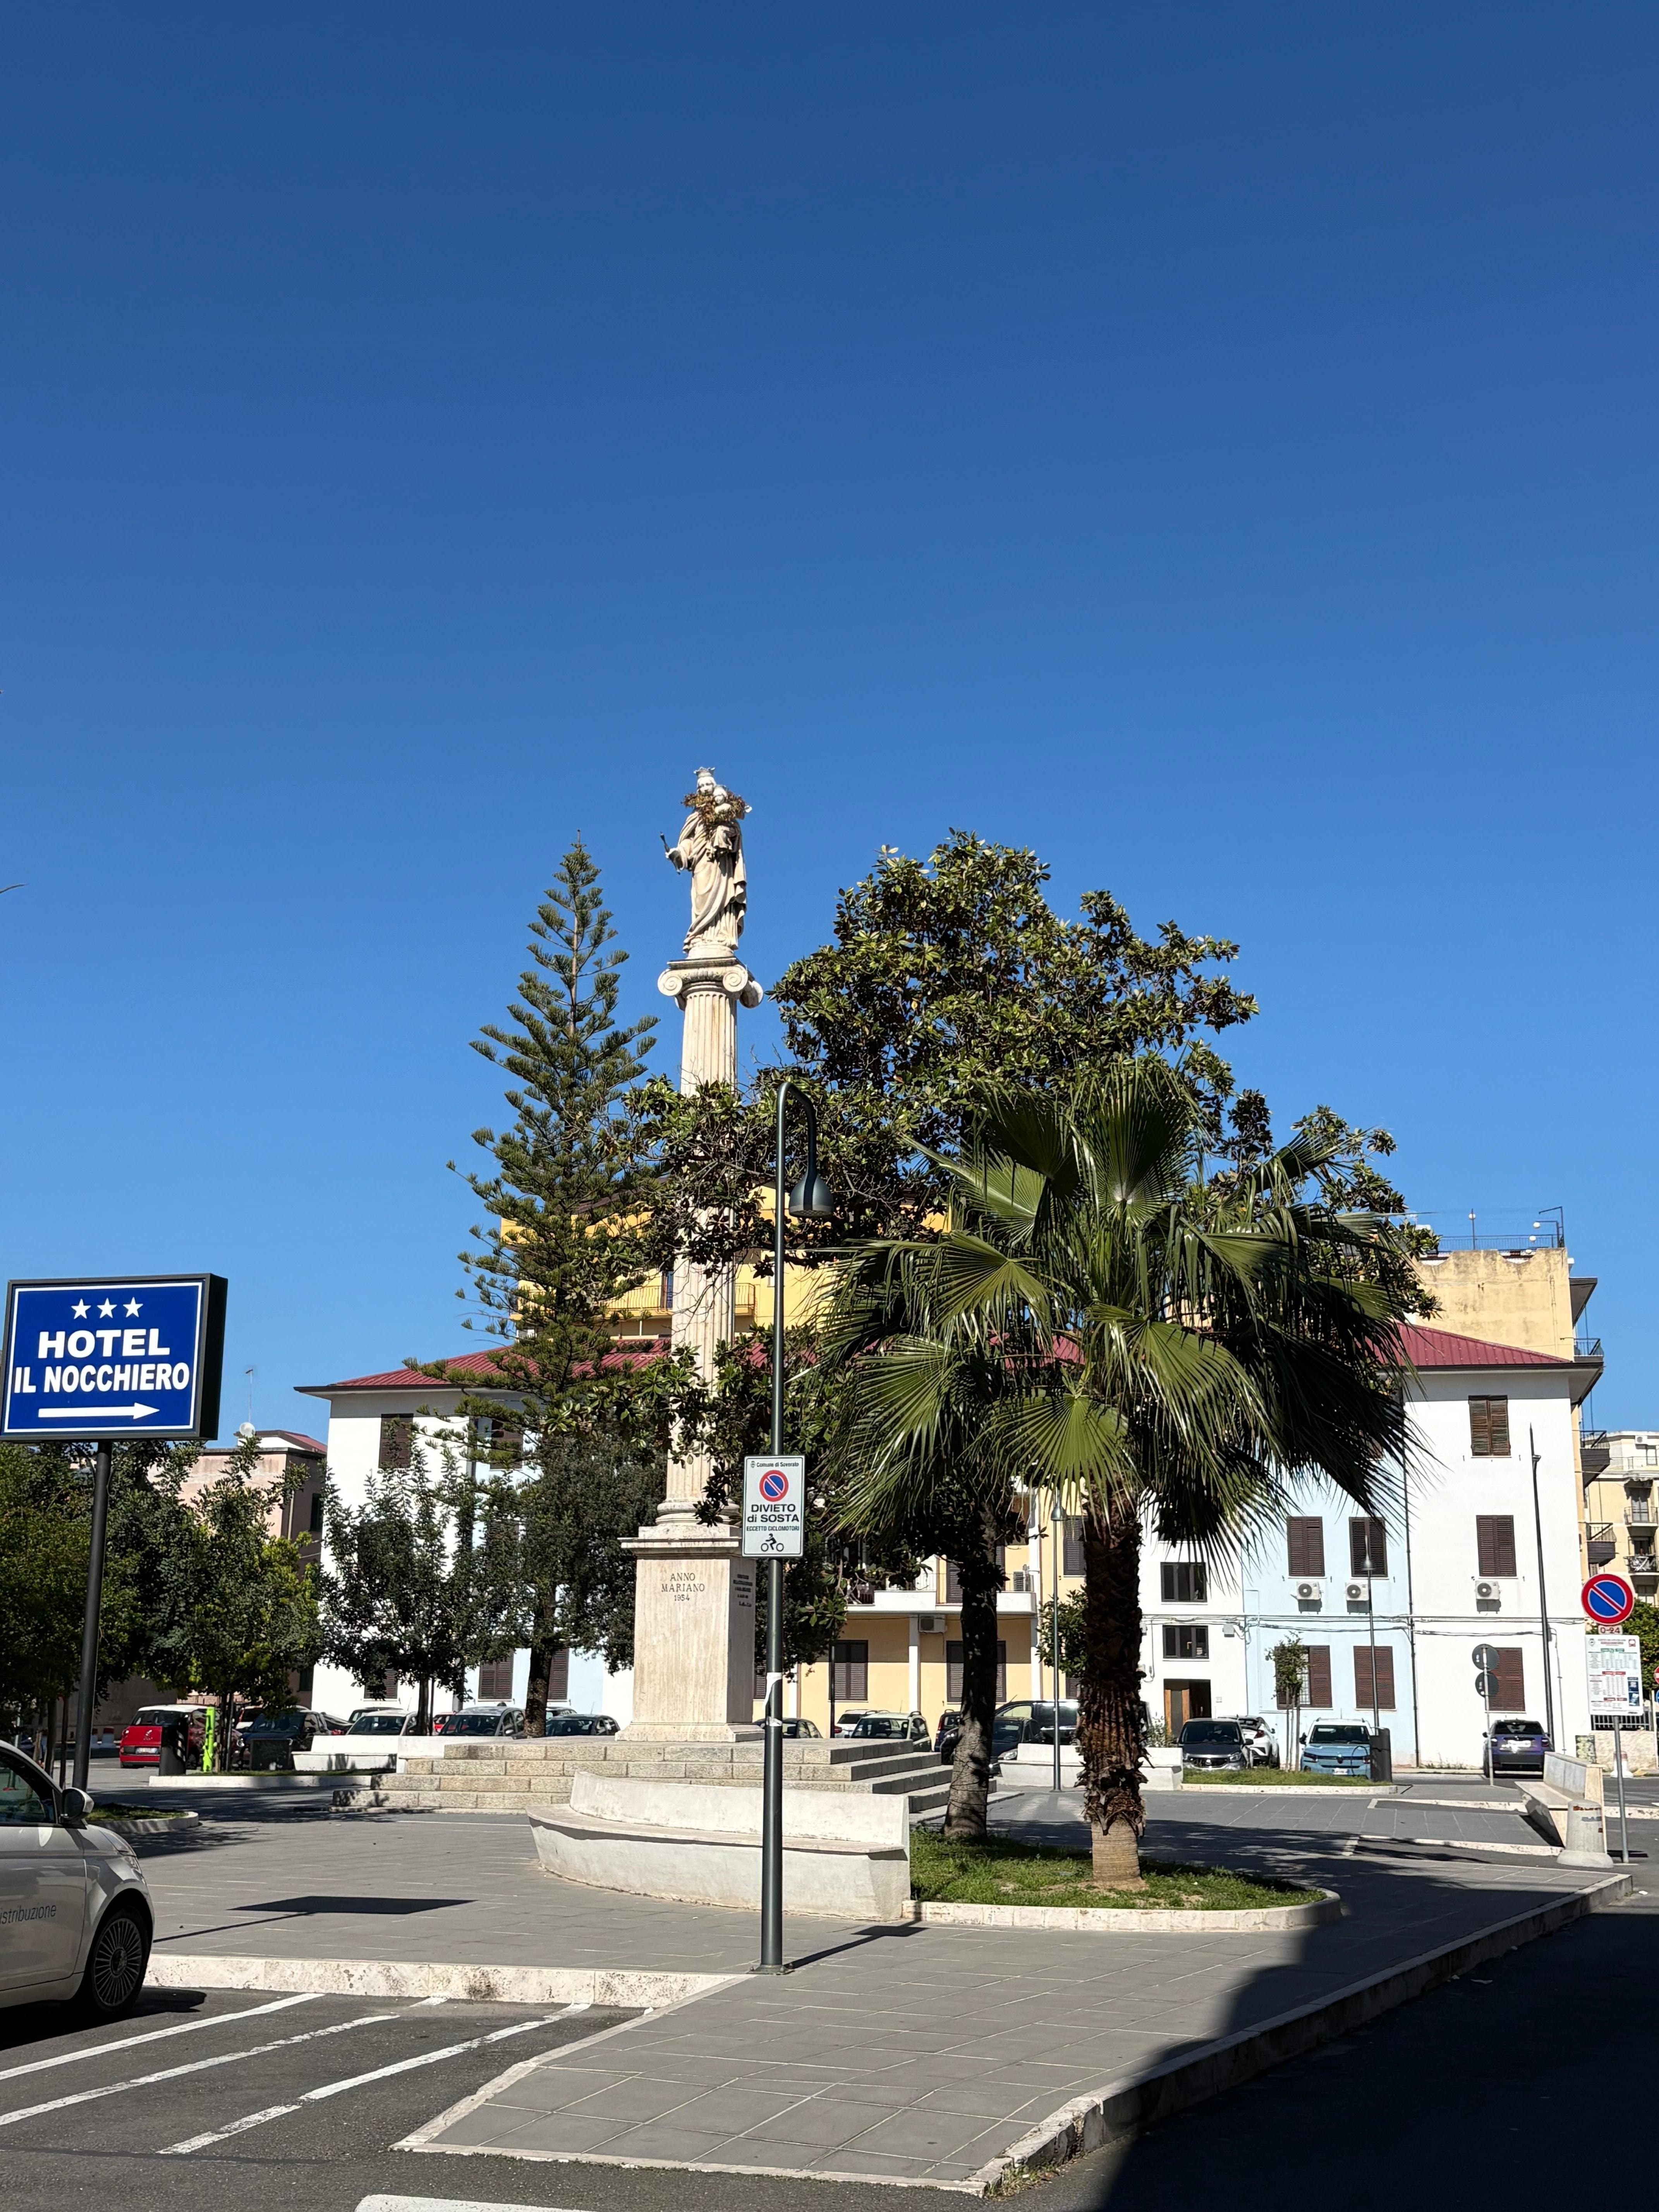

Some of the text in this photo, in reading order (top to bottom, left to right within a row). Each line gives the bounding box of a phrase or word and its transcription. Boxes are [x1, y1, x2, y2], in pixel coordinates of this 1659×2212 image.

[38, 1328, 170, 1358] HOTEL
[14, 1362, 189, 1393] IL NOCCHIERO
[751, 1504, 796, 1512] DIVIETO
[761, 1514, 799, 1522] SOSTA
[670, 1573, 696, 1581] ANNO
[661, 1583, 705, 1592] MARIANO
[674, 1593, 690, 1601] 1954
